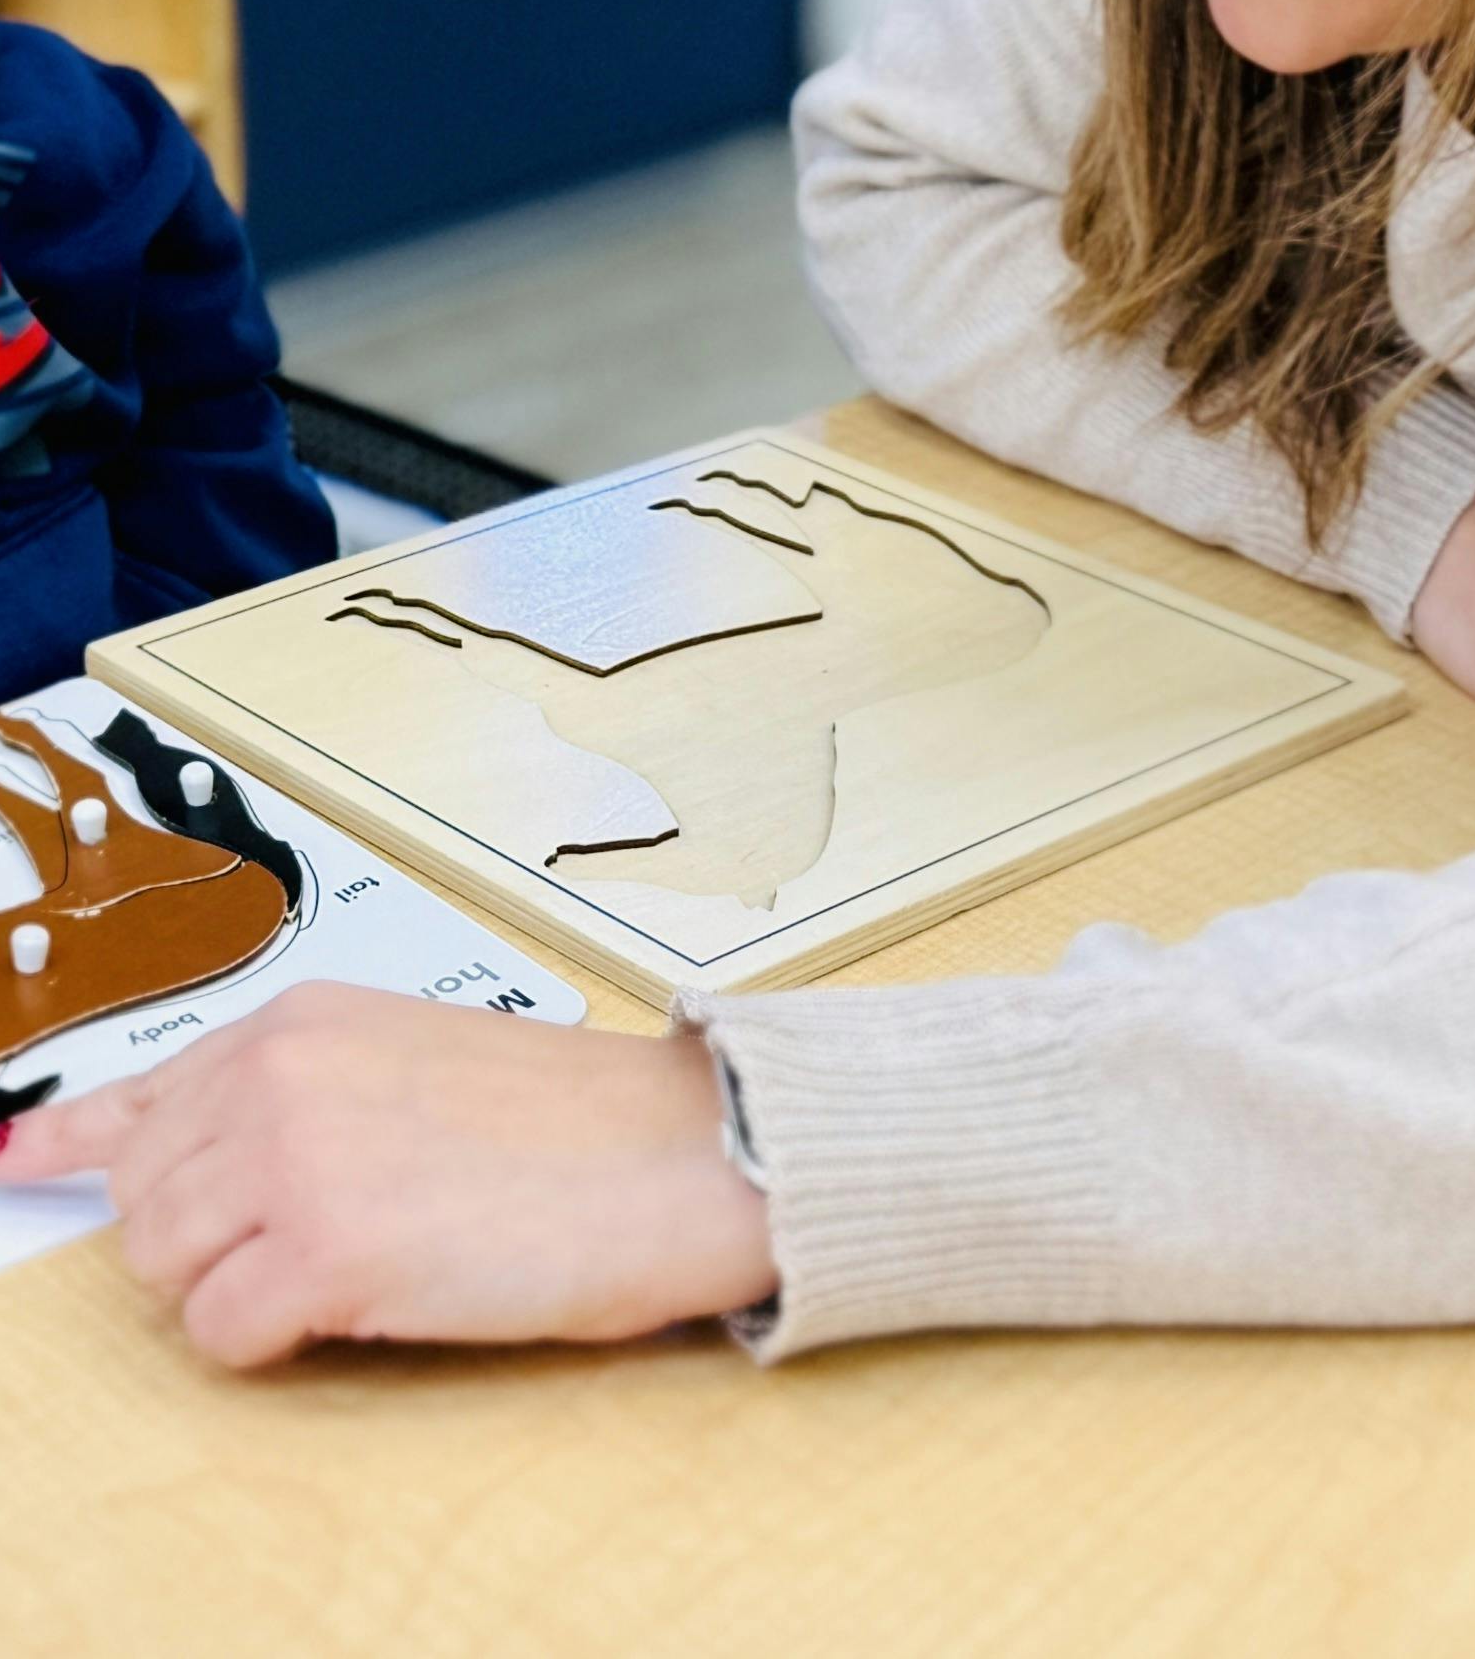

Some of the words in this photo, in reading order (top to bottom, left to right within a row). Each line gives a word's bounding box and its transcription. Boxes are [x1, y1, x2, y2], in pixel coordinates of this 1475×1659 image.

[334, 877, 381, 903] tail
[419, 961, 501, 1000] hor
[128, 1012, 204, 1046] body
